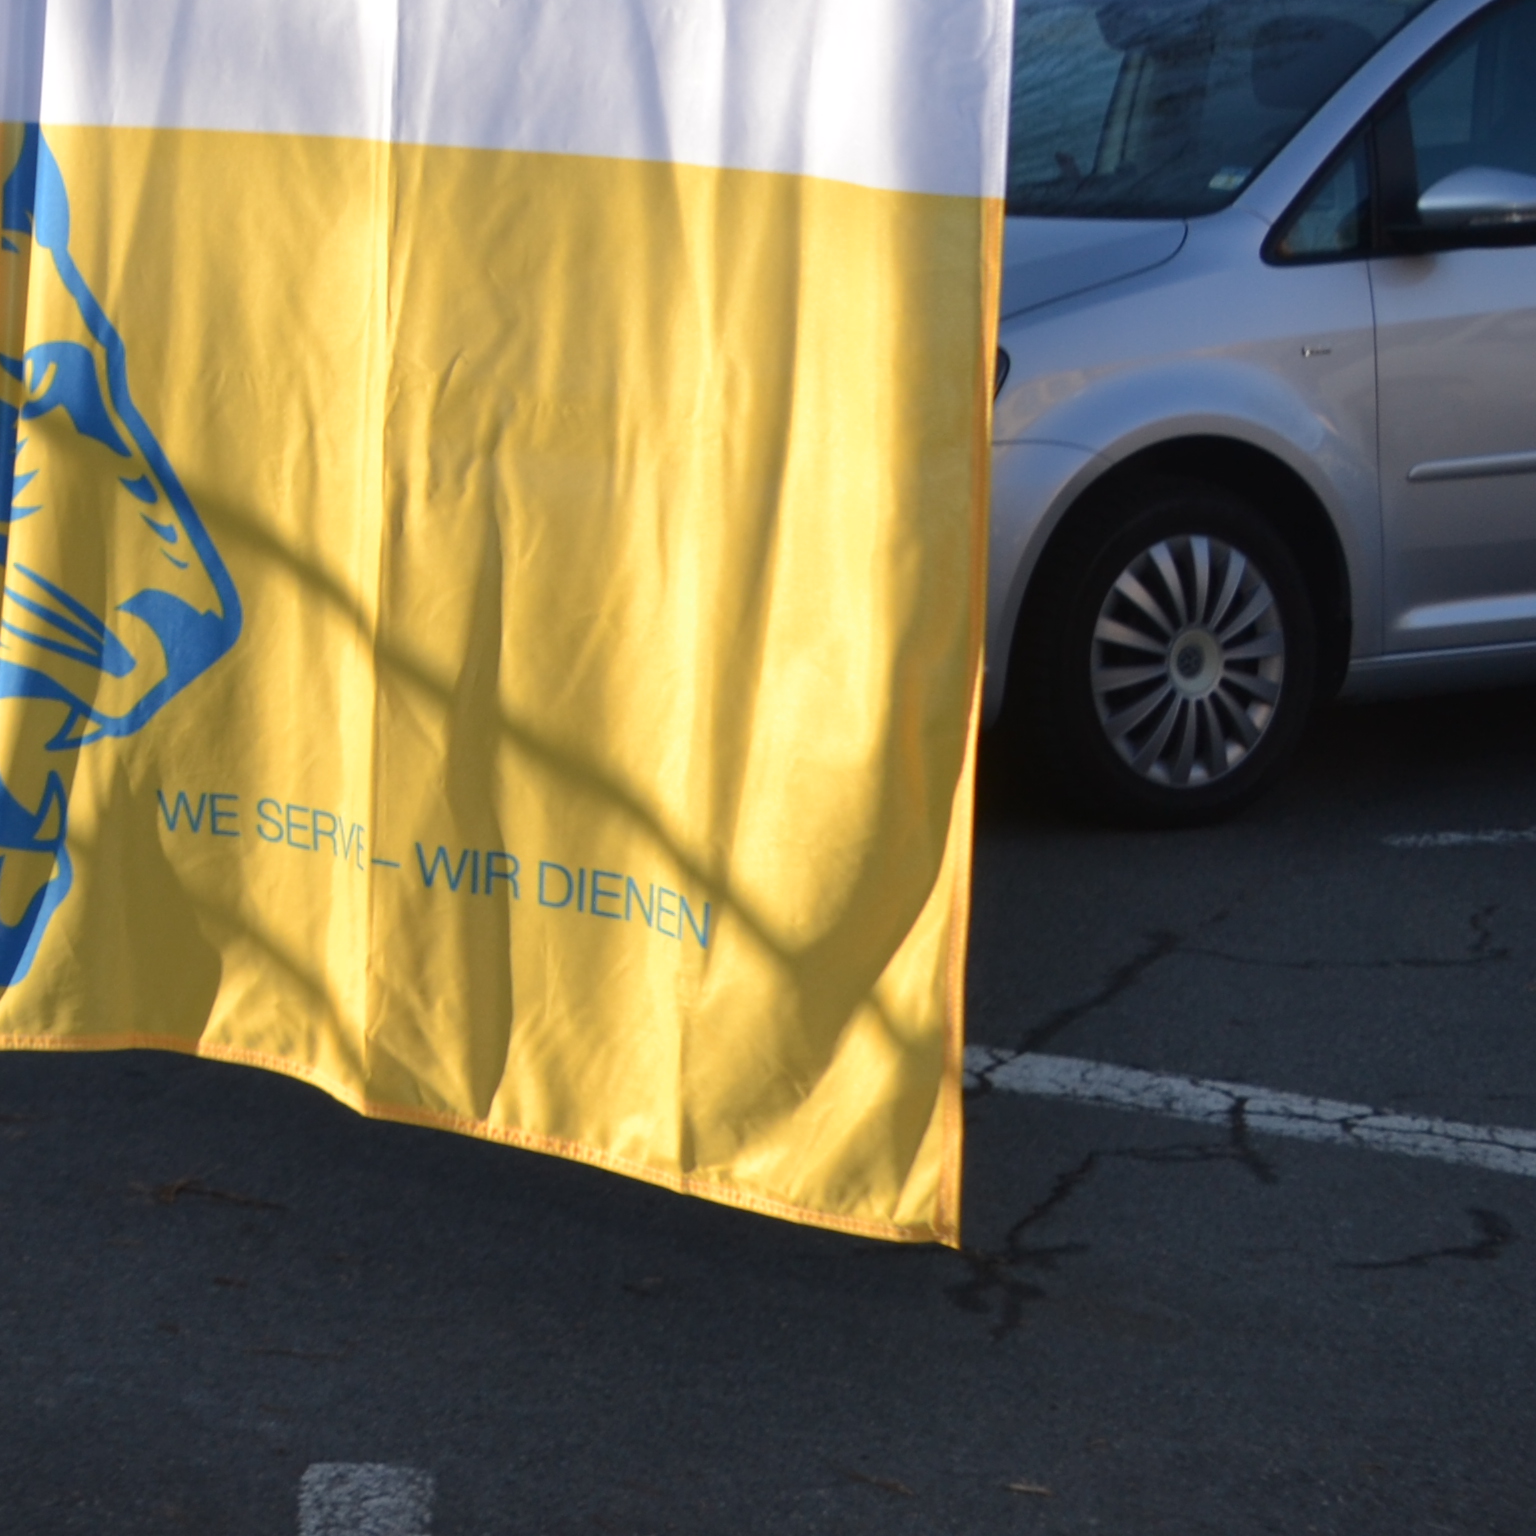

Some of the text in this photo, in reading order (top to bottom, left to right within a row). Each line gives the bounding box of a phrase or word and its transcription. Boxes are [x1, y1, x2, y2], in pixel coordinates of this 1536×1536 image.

[156, 788, 239, 837] WE
[256, 797, 366, 872] SERVE
[414, 840, 521, 900] WIR
[537, 860, 712, 949] DIENEN
